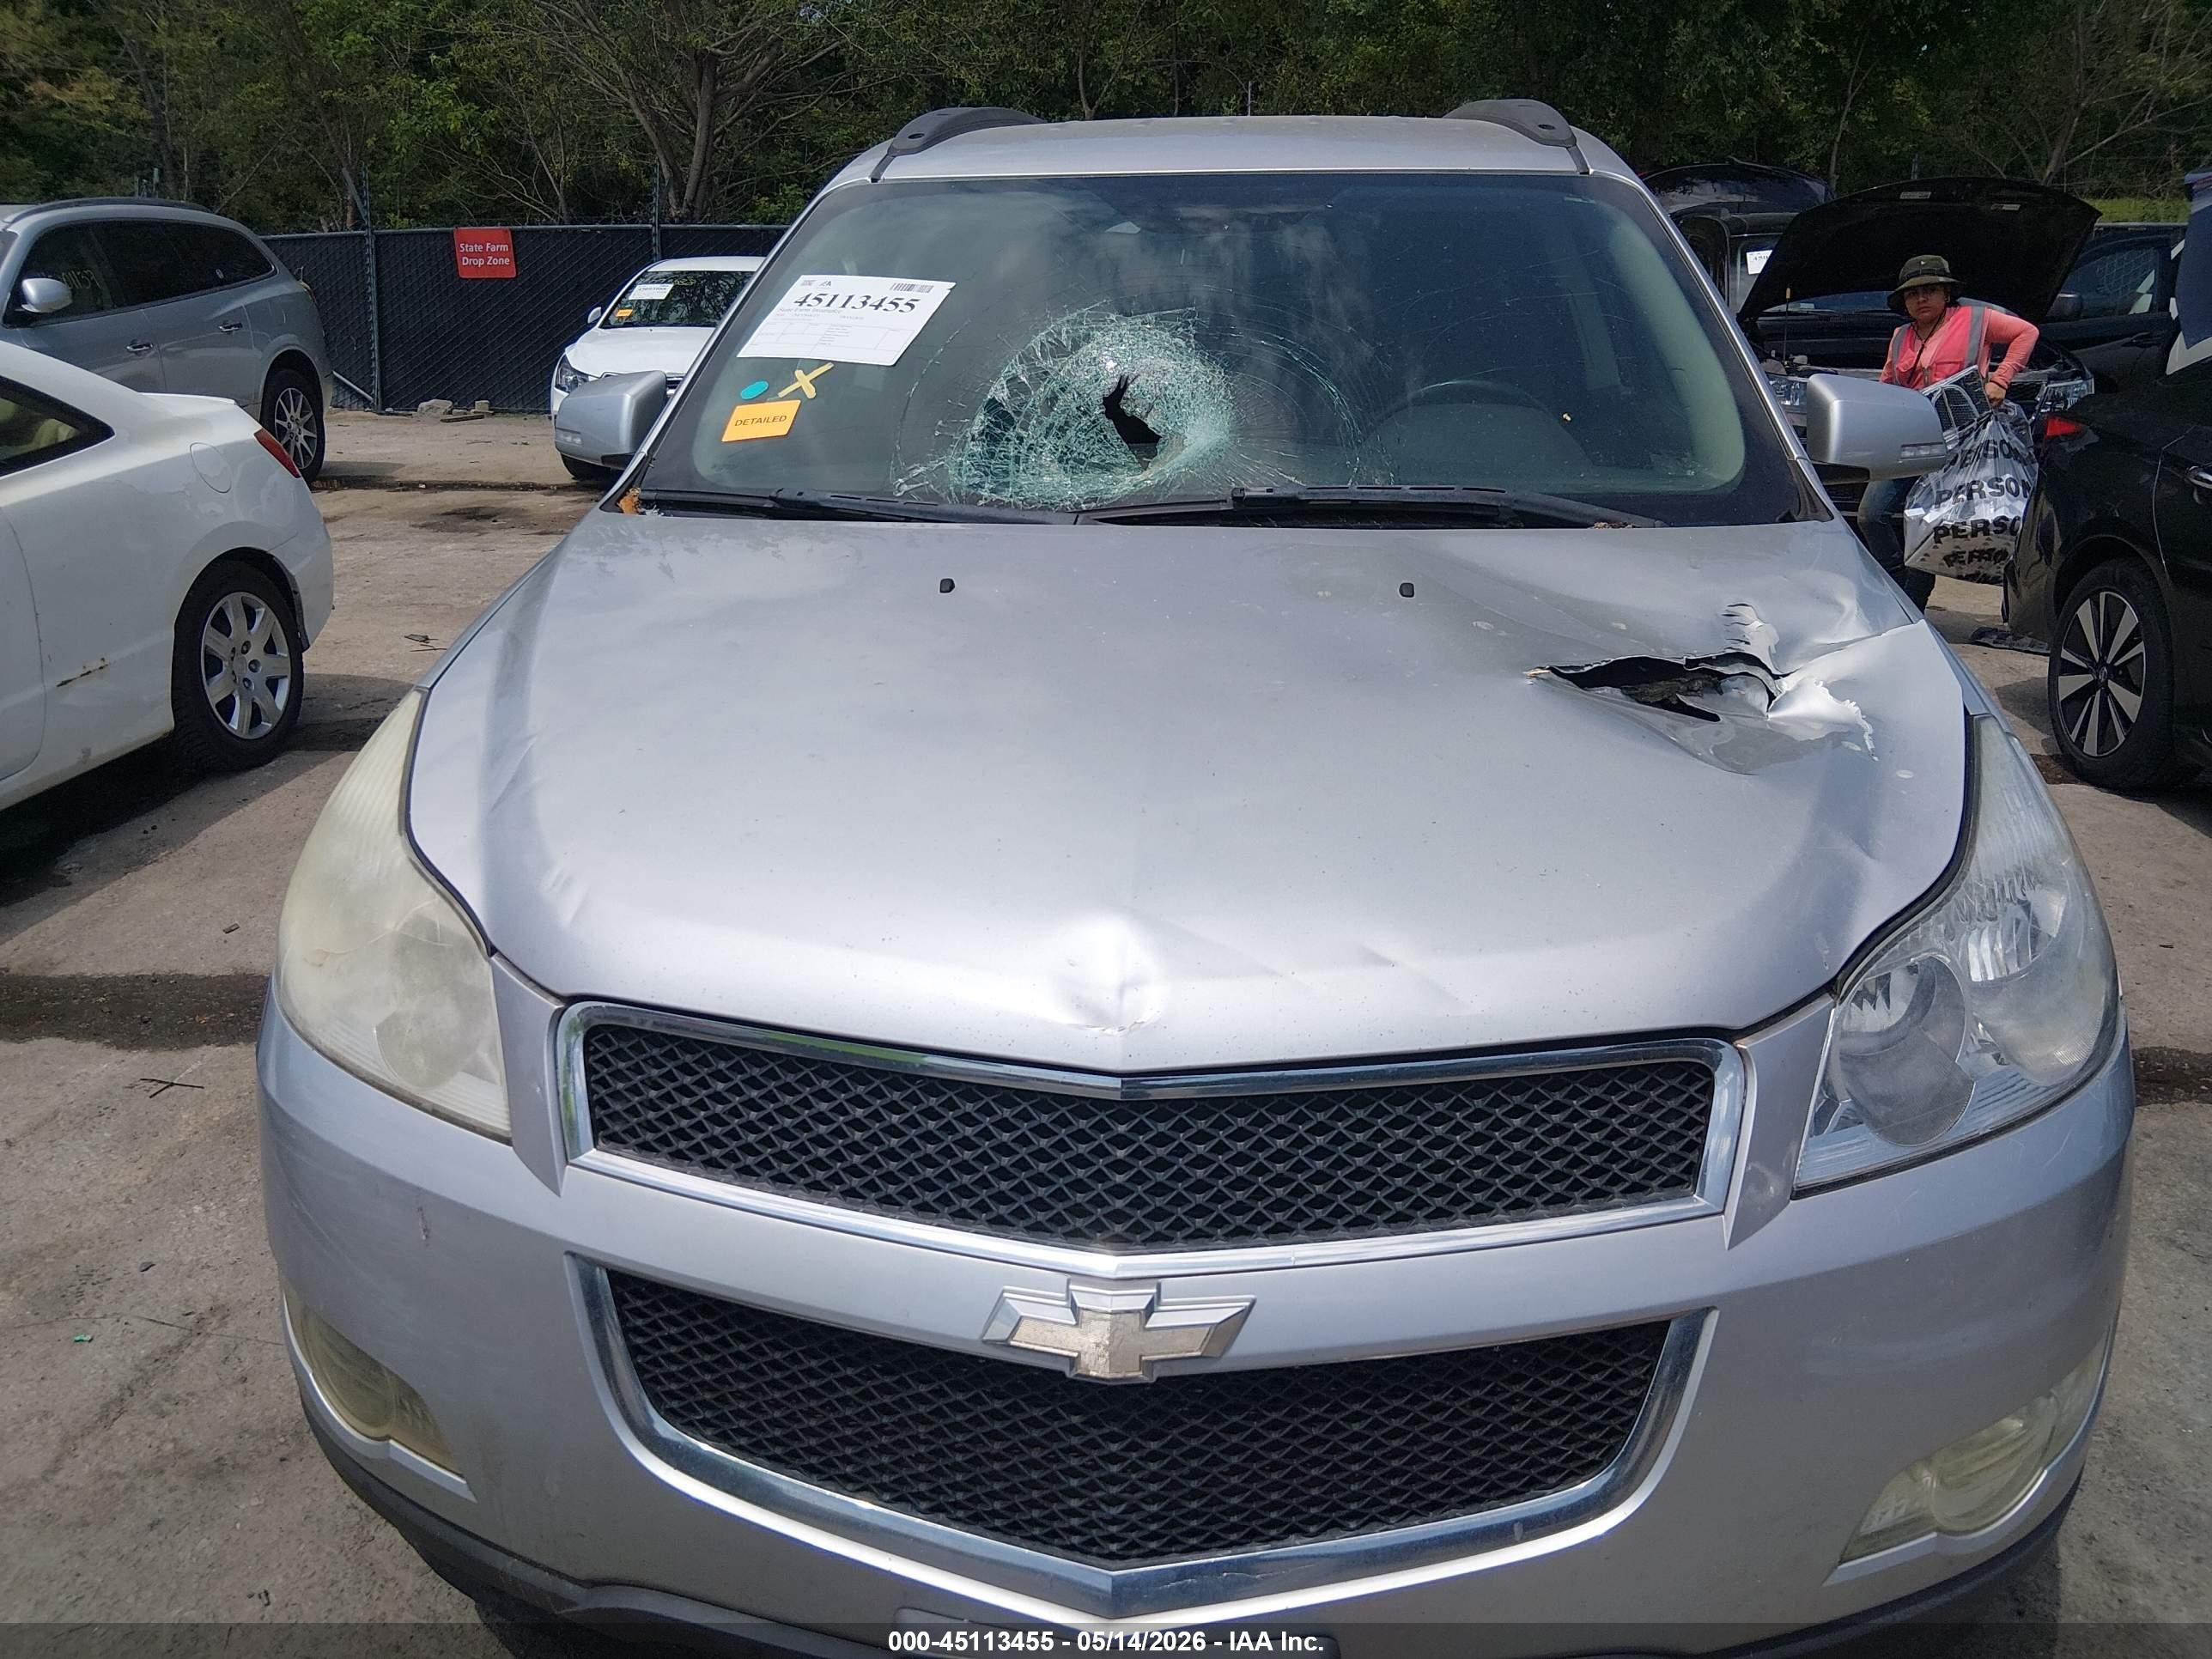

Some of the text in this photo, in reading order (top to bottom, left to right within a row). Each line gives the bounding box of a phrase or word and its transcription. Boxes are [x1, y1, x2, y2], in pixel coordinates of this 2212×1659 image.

[459, 242, 509, 252] State Farm
[462, 256, 510, 268] Drop Zone
[793, 292, 921, 313] 45113455
[734, 415, 787, 427] DETAILED
